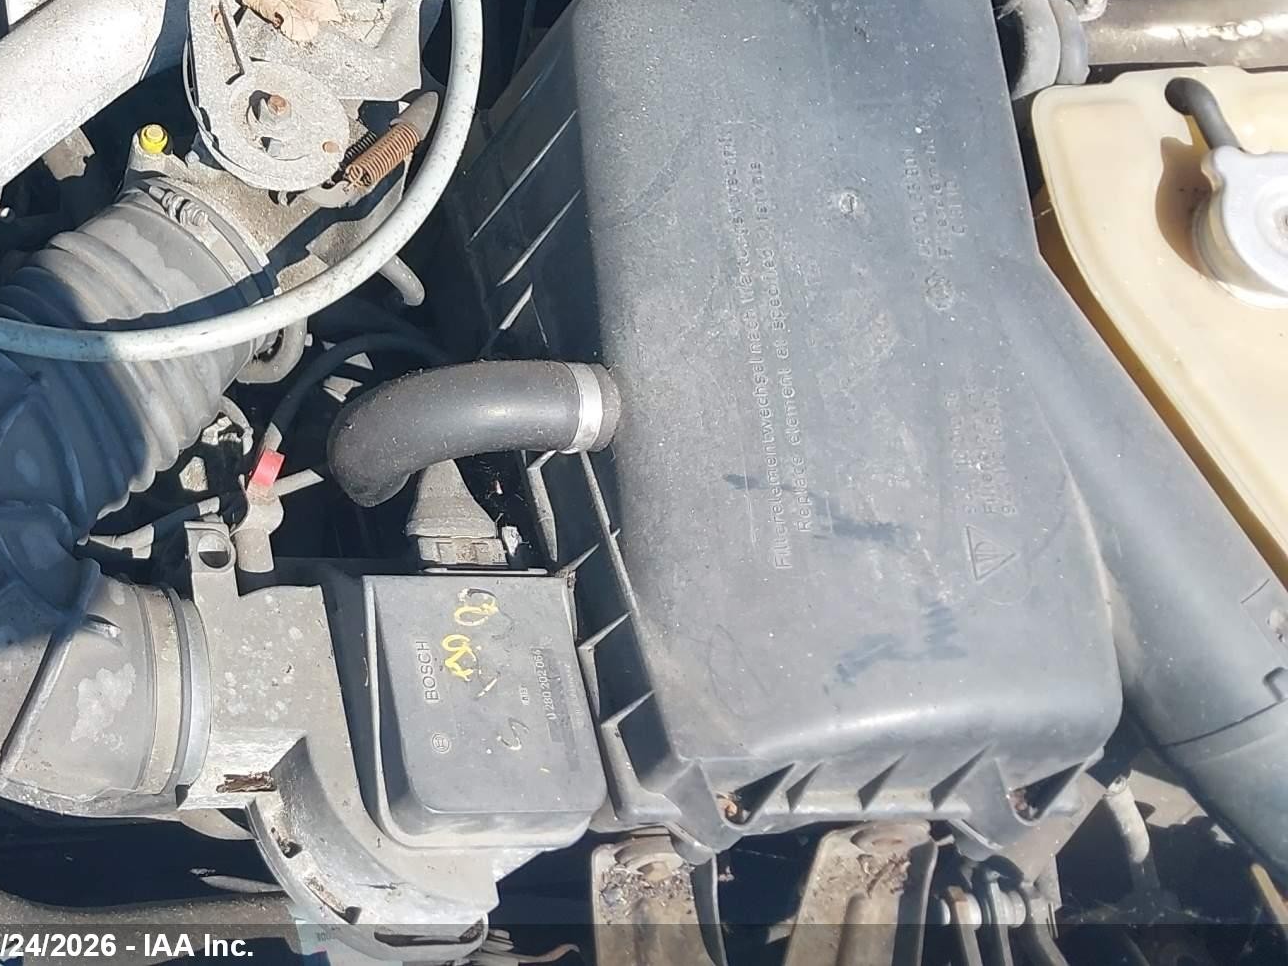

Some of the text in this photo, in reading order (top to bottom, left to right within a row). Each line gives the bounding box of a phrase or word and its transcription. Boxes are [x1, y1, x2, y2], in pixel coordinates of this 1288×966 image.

[777, 367, 801, 447] element
[788, 454, 813, 533] Replace
[416, 641, 440, 702] BOSCH
